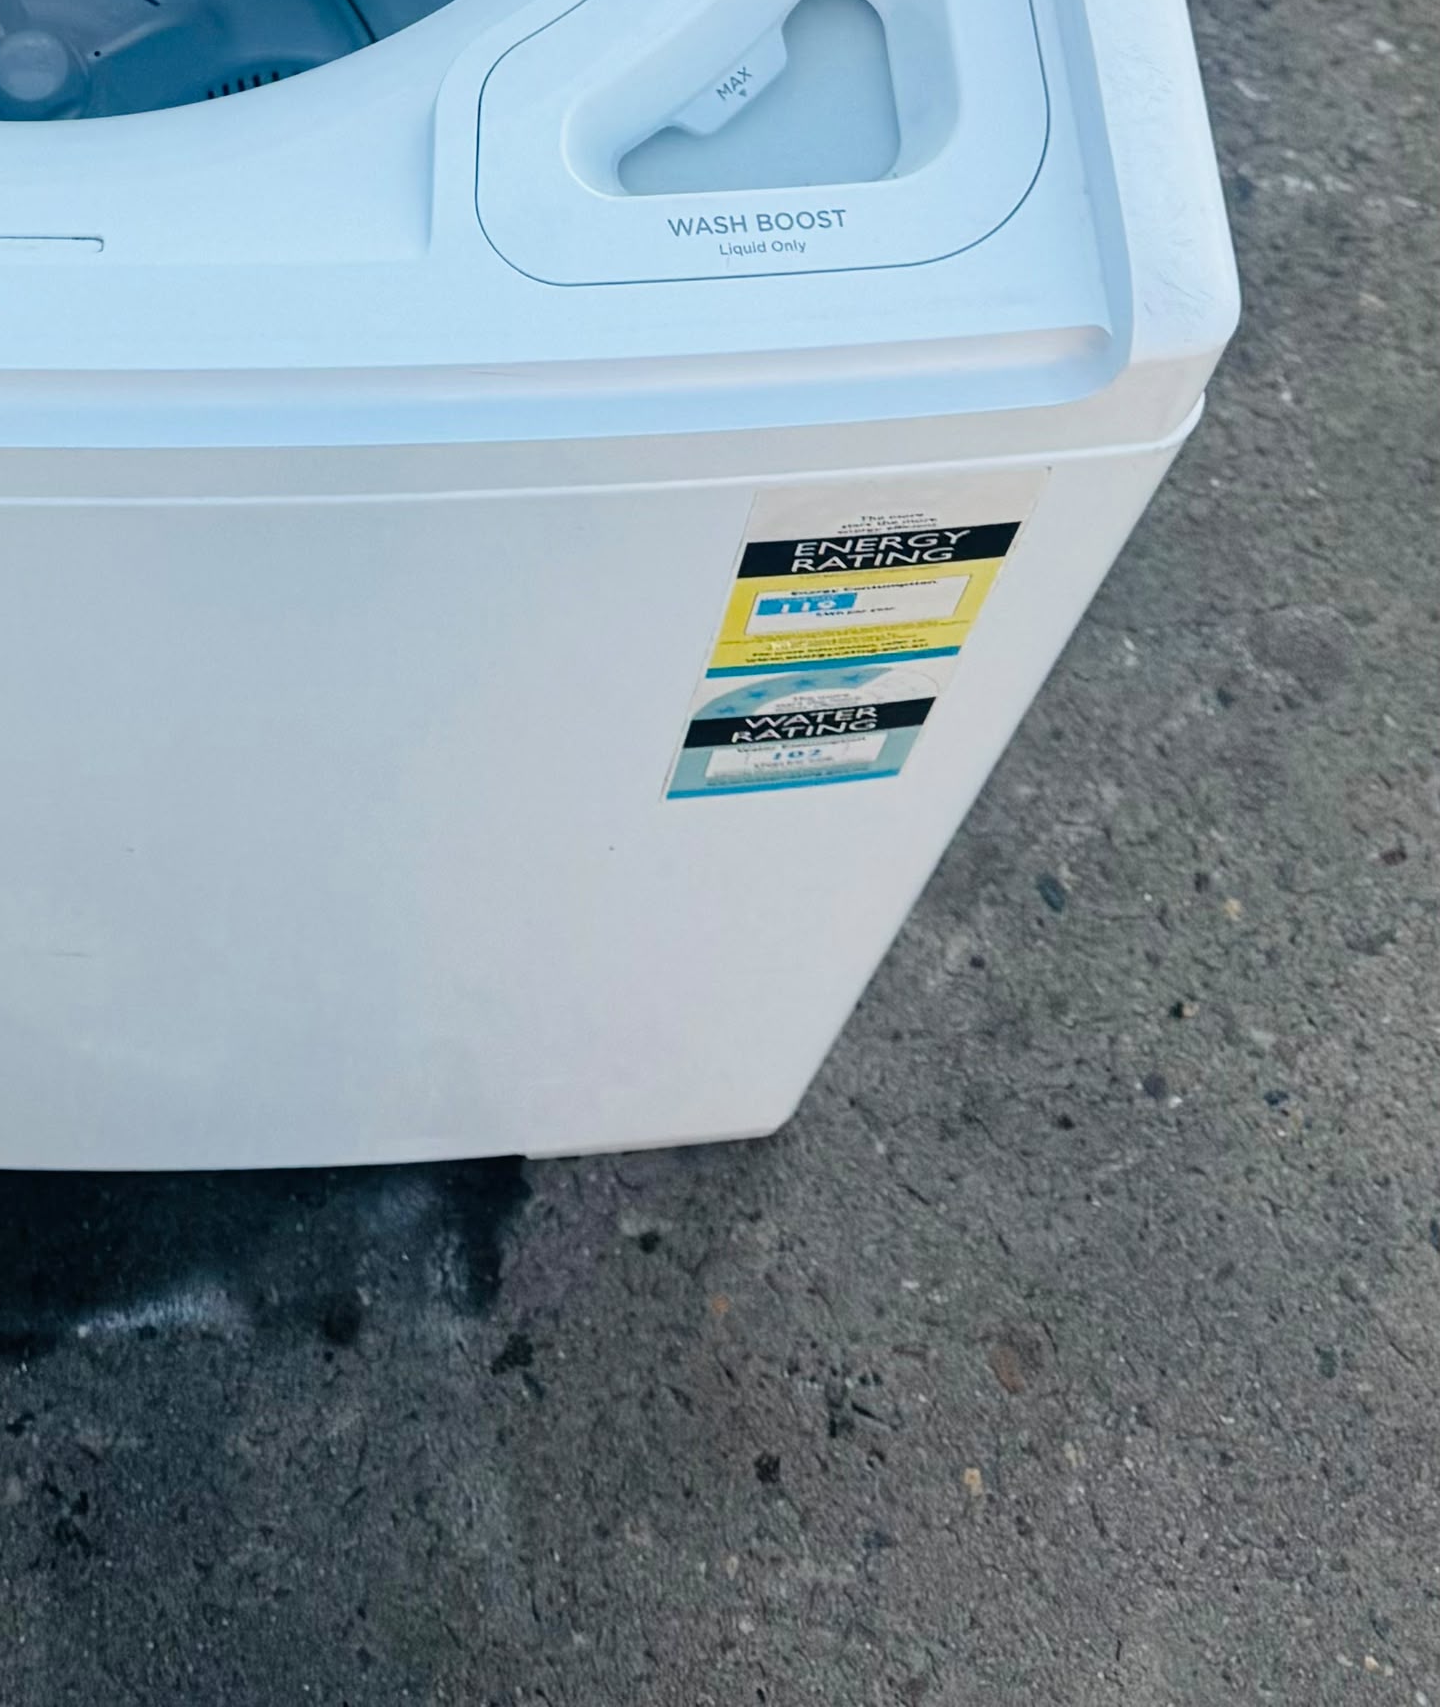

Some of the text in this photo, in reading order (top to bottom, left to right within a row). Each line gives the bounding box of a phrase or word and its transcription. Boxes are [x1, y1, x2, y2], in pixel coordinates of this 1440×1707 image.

[715, 66, 753, 101] MAX
[667, 209, 847, 237] WASH BOOST
[719, 239, 807, 257] Liquid Only
[793, 529, 970, 558] ENERGY
[790, 547, 955, 573] RATING
[731, 718, 876, 744] RATING
[744, 706, 878, 730] WATER
